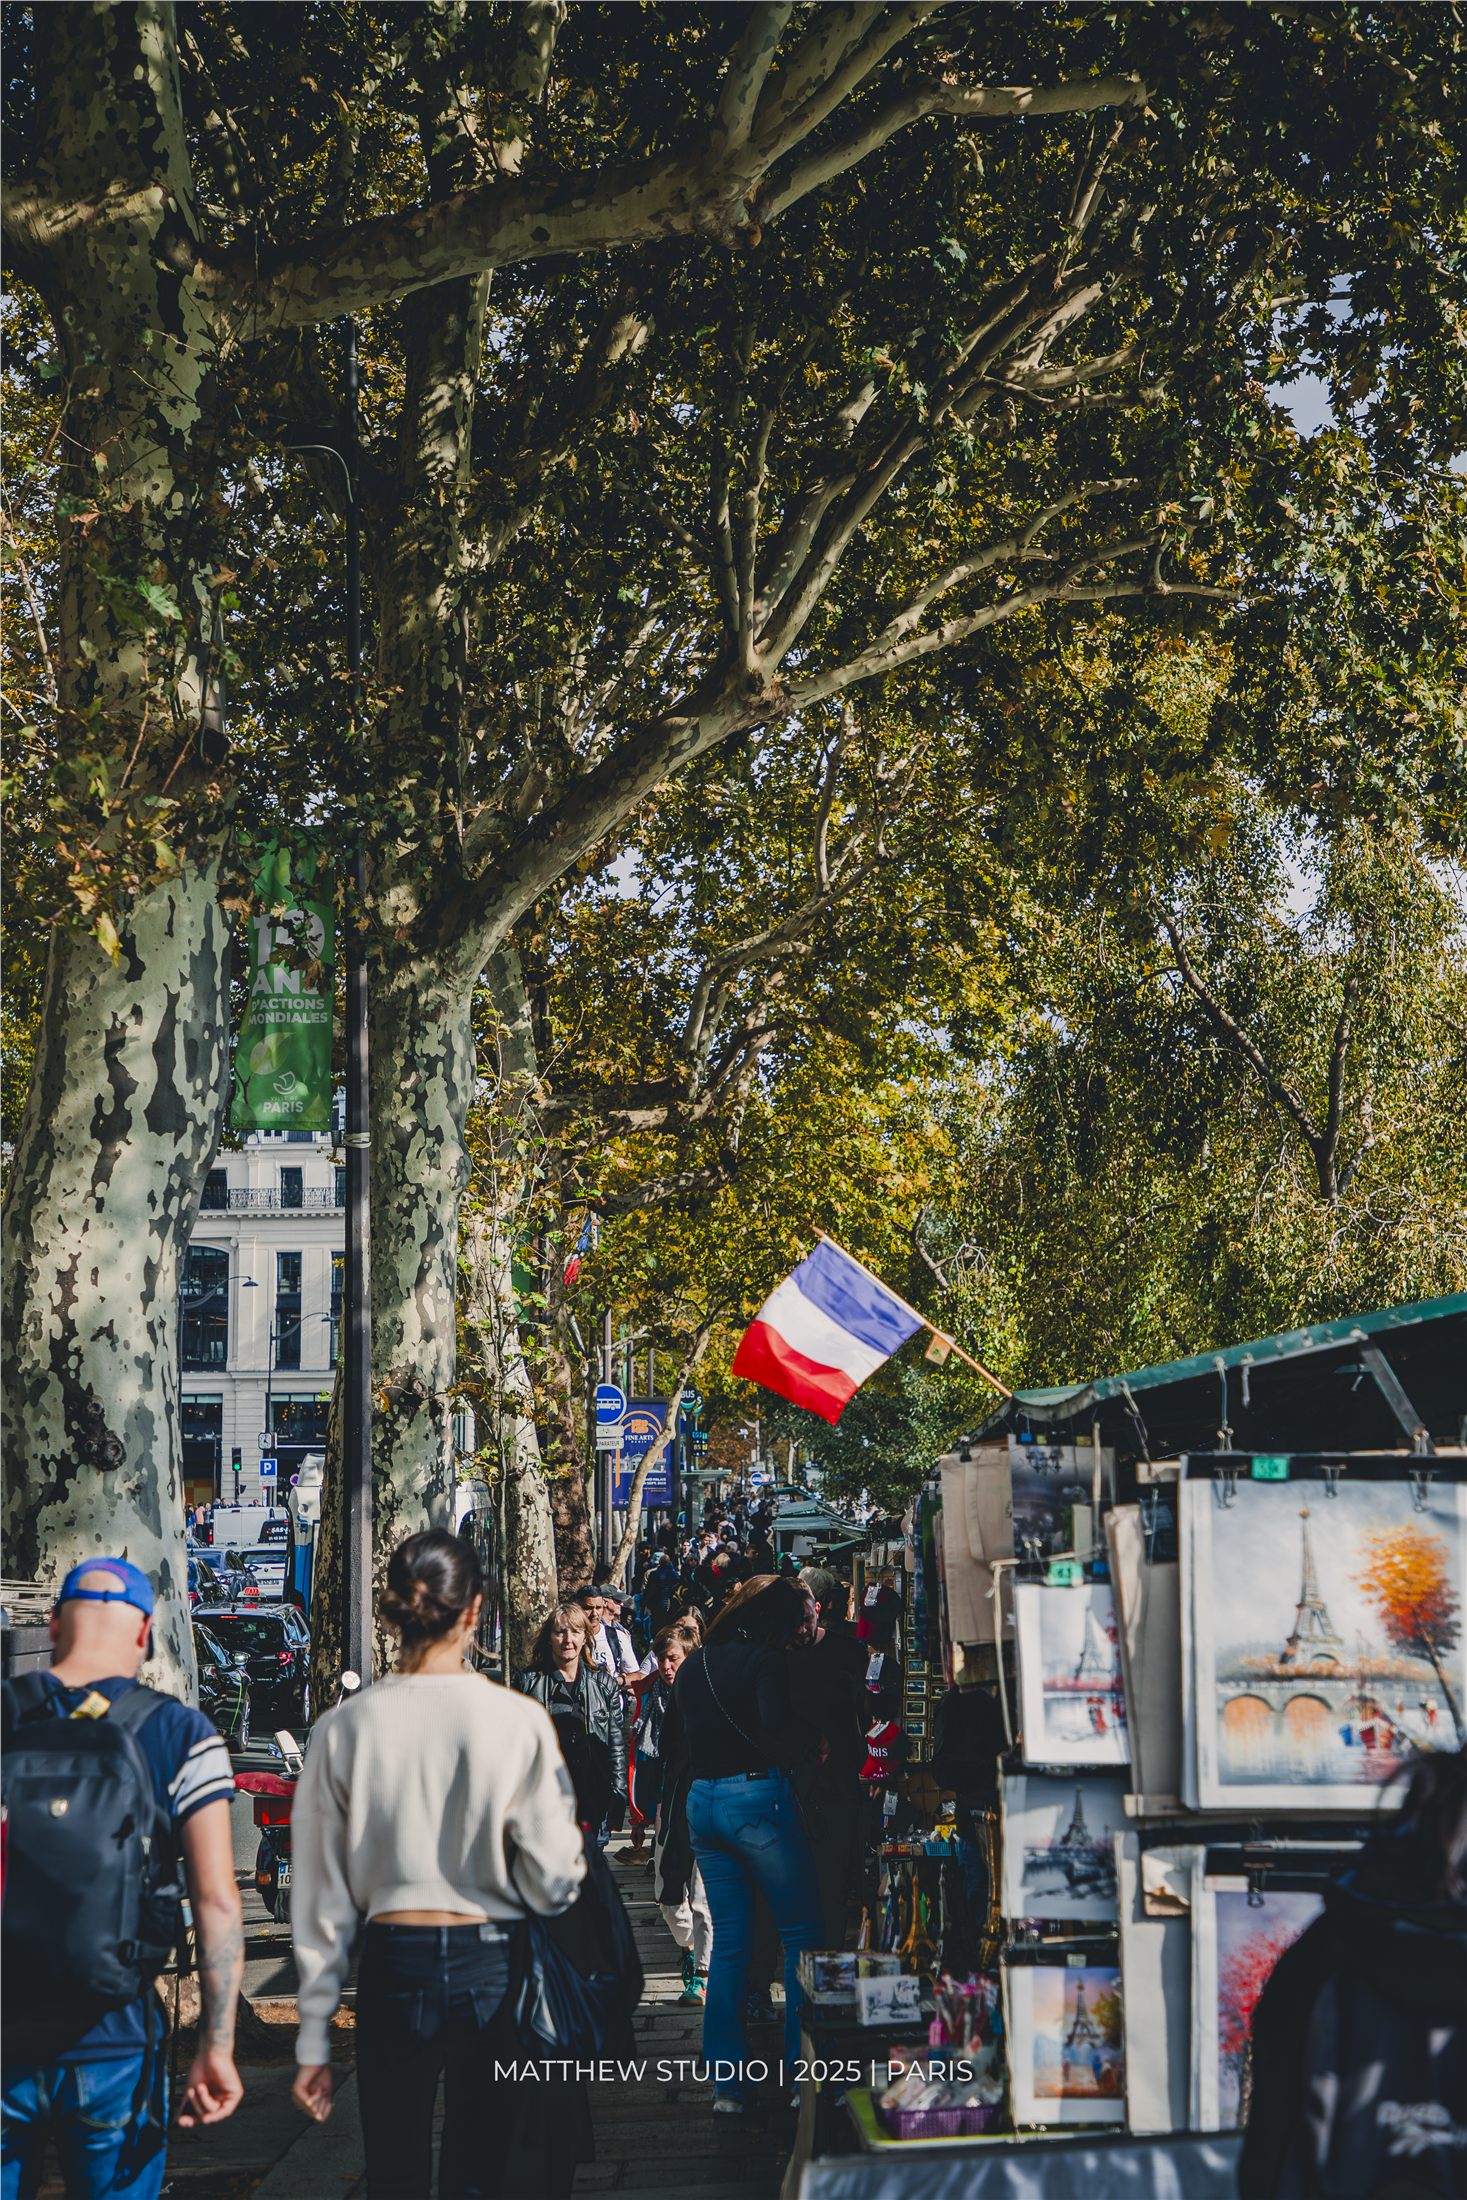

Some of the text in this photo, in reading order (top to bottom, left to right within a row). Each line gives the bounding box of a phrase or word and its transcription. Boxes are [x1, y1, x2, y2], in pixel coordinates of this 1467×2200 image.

[251, 966, 320, 997] AN
[251, 998, 325, 1012] D'ACTIONS
[248, 1012, 328, 1026] MONDIALES
[262, 1102, 304, 1113] PARIS
[681, 1390, 695, 1398] BUS
[264, 1462, 272, 1474] P
